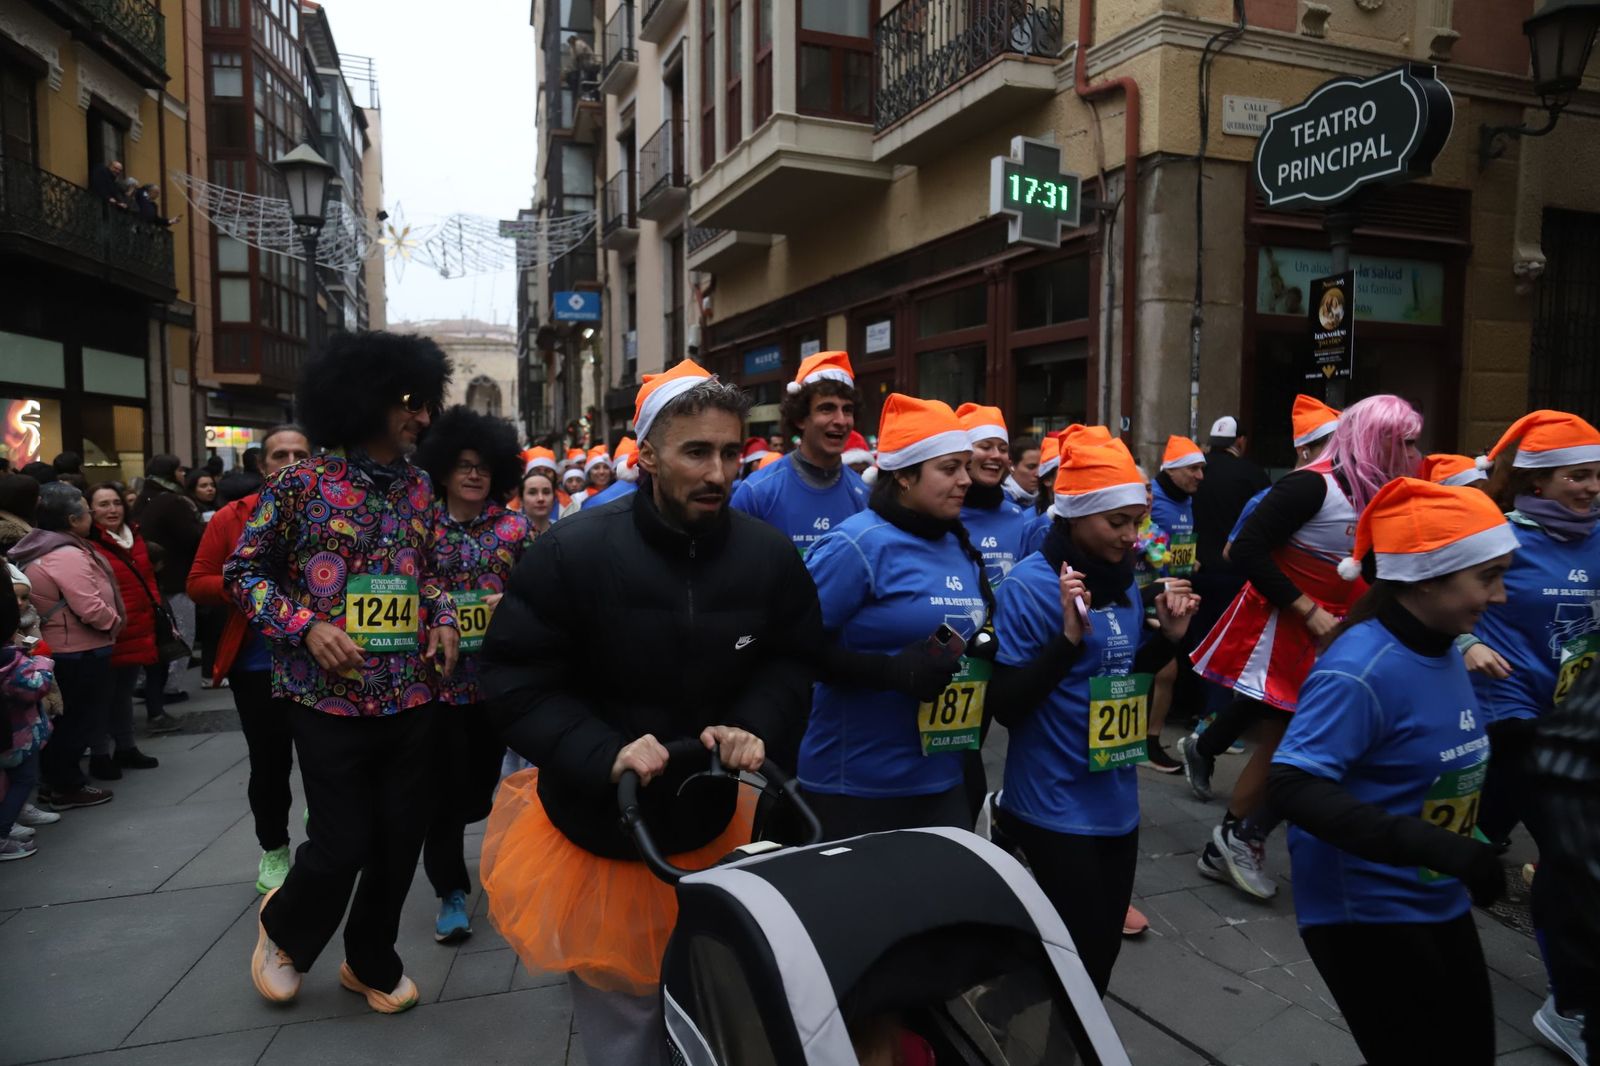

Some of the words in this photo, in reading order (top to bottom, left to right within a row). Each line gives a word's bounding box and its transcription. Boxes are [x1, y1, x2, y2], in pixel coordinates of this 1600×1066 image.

[1243, 102, 1268, 112] CALLE
[1248, 113, 1259, 121] DE
[1290, 100, 1377, 147] TEATRO
[1277, 133, 1392, 187] PRINCIPAL
[1009, 174, 1068, 211] 17:31
[1294, 260, 1309, 273] Un
[1371, 264, 1403, 280] salud
[1357, 284, 1369, 294] su
[1370, 283, 1402, 296] familia
[813, 517, 830, 530] 46
[981, 536, 998, 548] 46
[1567, 569, 1589, 582] 46
[945, 575, 963, 591] 46
[1542, 588, 1559, 596] SAN
[1559, 588, 1595, 597] SILVESTRE
[930, 596, 944, 606] SAN
[944, 597, 973, 607] SILVESTRE
[353, 597, 412, 627] 1244
[370, 638, 393, 646] CAJA
[394, 637, 415, 645] RURAL
[929, 688, 975, 725] 187
[1099, 701, 1138, 741] 201
[1111, 751, 1126, 761] CAJA
[1440, 748, 1457, 762] SAN
